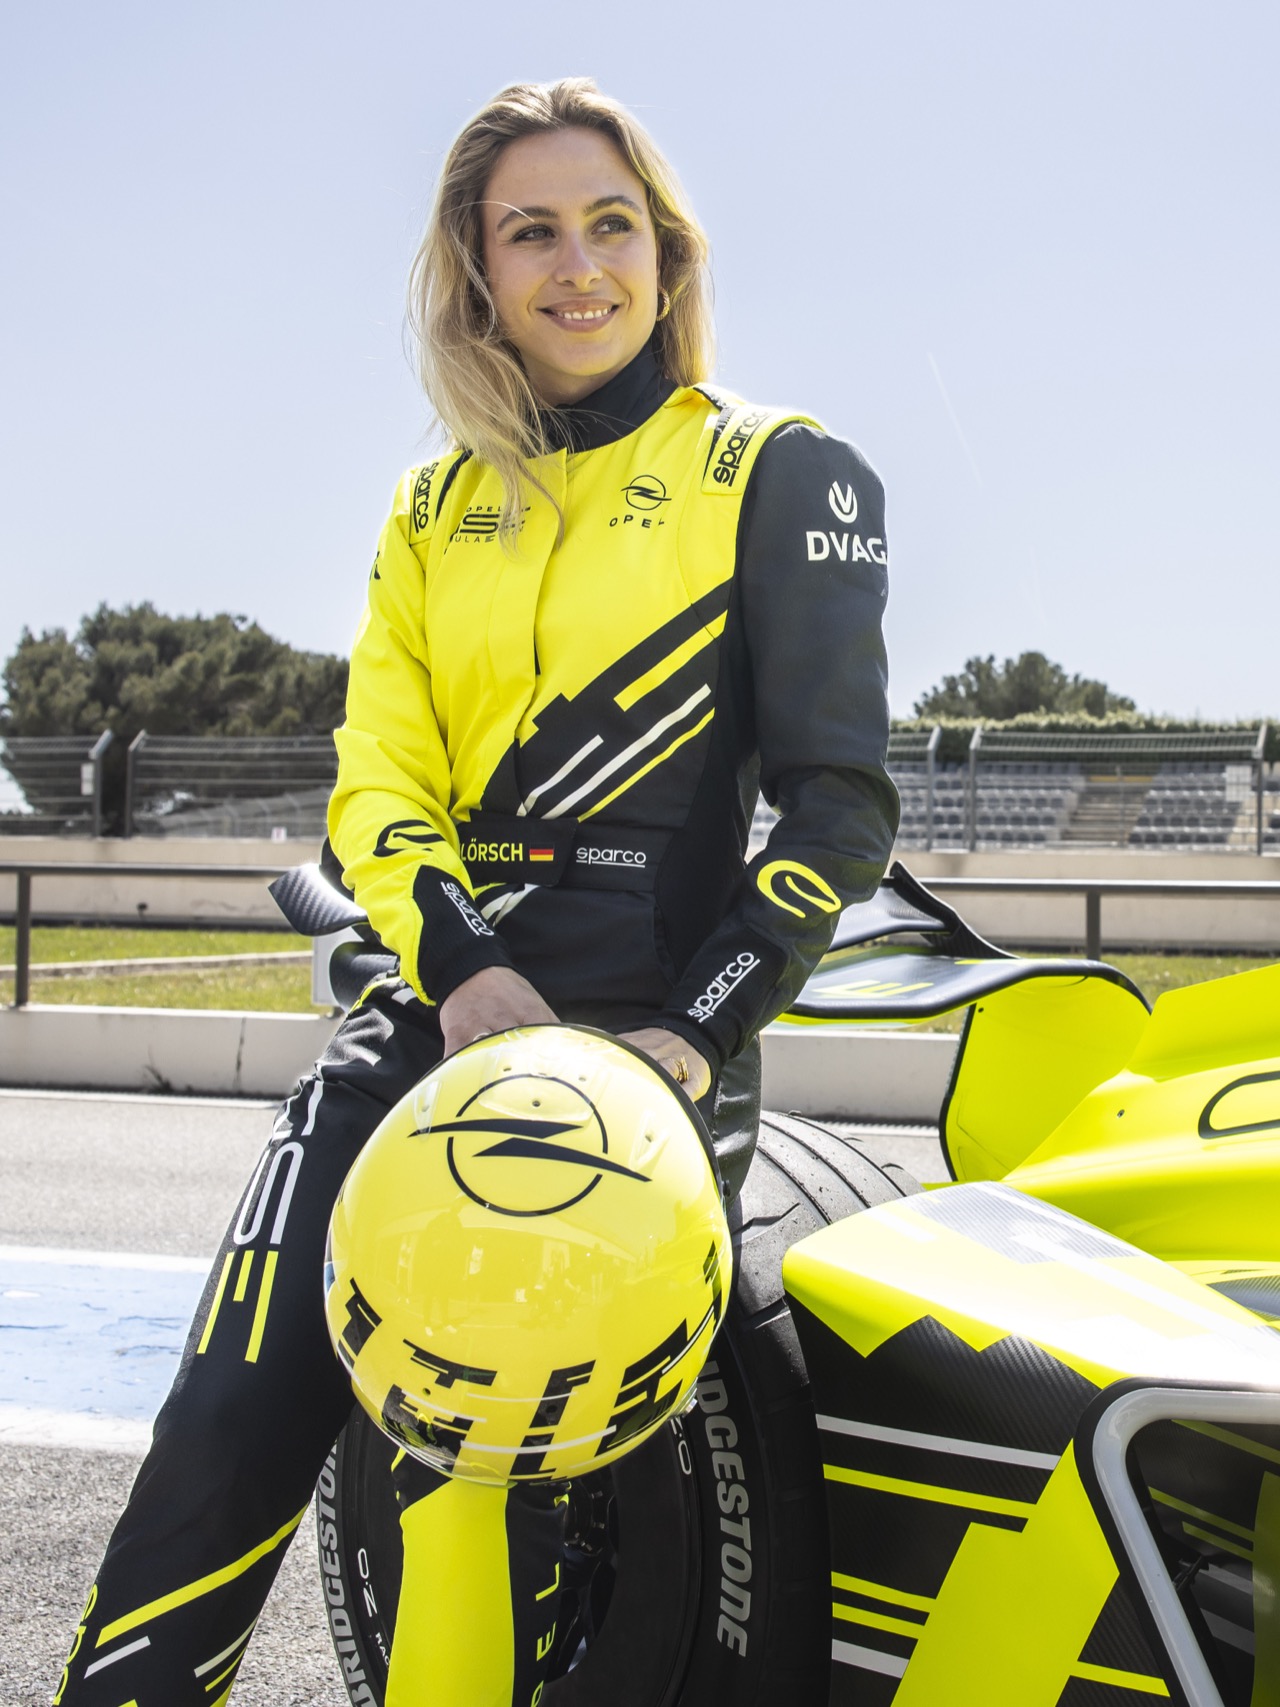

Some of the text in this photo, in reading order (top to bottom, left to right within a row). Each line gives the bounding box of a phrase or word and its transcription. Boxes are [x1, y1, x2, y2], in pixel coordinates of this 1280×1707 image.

[413, 462, 439, 534] sparco
[806, 531, 887, 565] DVAG
[461, 838, 523, 862] LÖRSCH
[576, 847, 647, 868] sparco
[440, 881, 495, 936] sparco
[687, 952, 761, 1023] sparco
[697, 1360, 753, 1658] IDGESTONE
[316, 1439, 377, 1707] BRIDGESTO
[375, 1631, 390, 1668] RAC
